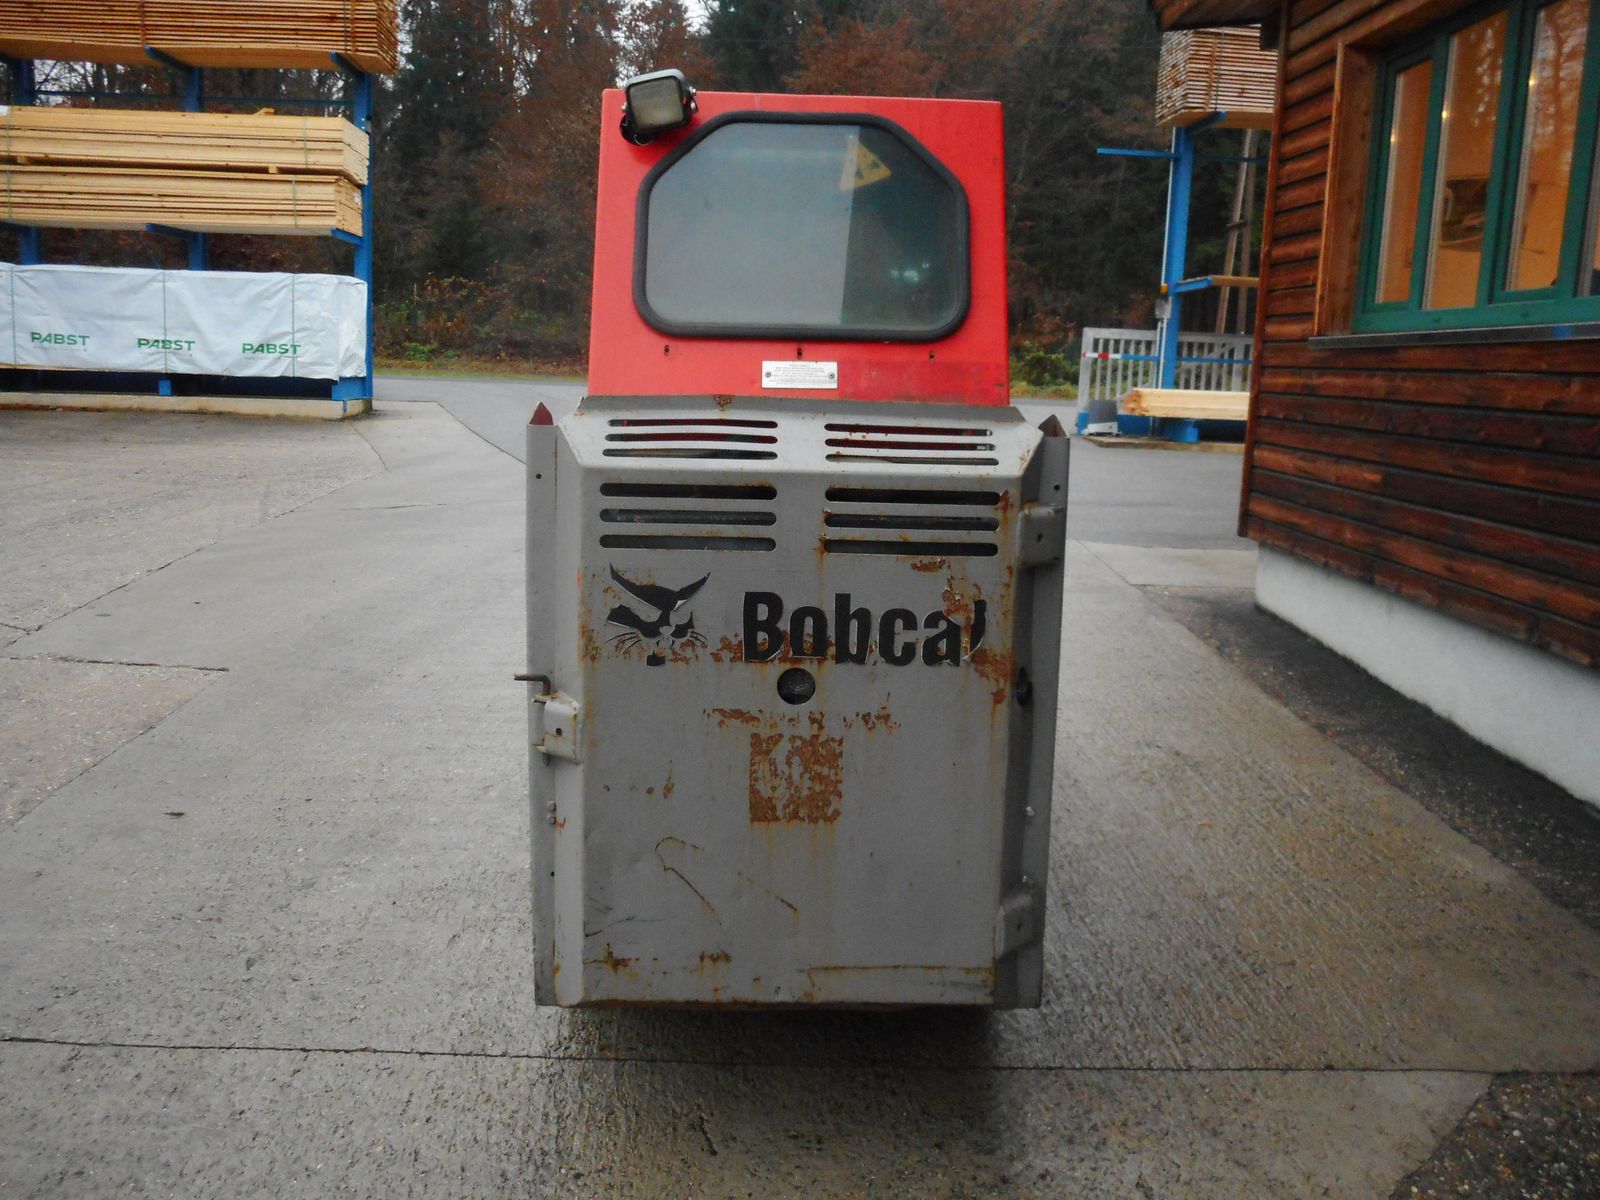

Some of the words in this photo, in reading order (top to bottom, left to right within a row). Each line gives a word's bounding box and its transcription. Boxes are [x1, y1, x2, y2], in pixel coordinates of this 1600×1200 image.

[31, 332, 90, 346] PABST
[137, 338, 195, 352] PABST
[242, 343, 302, 355] PABST
